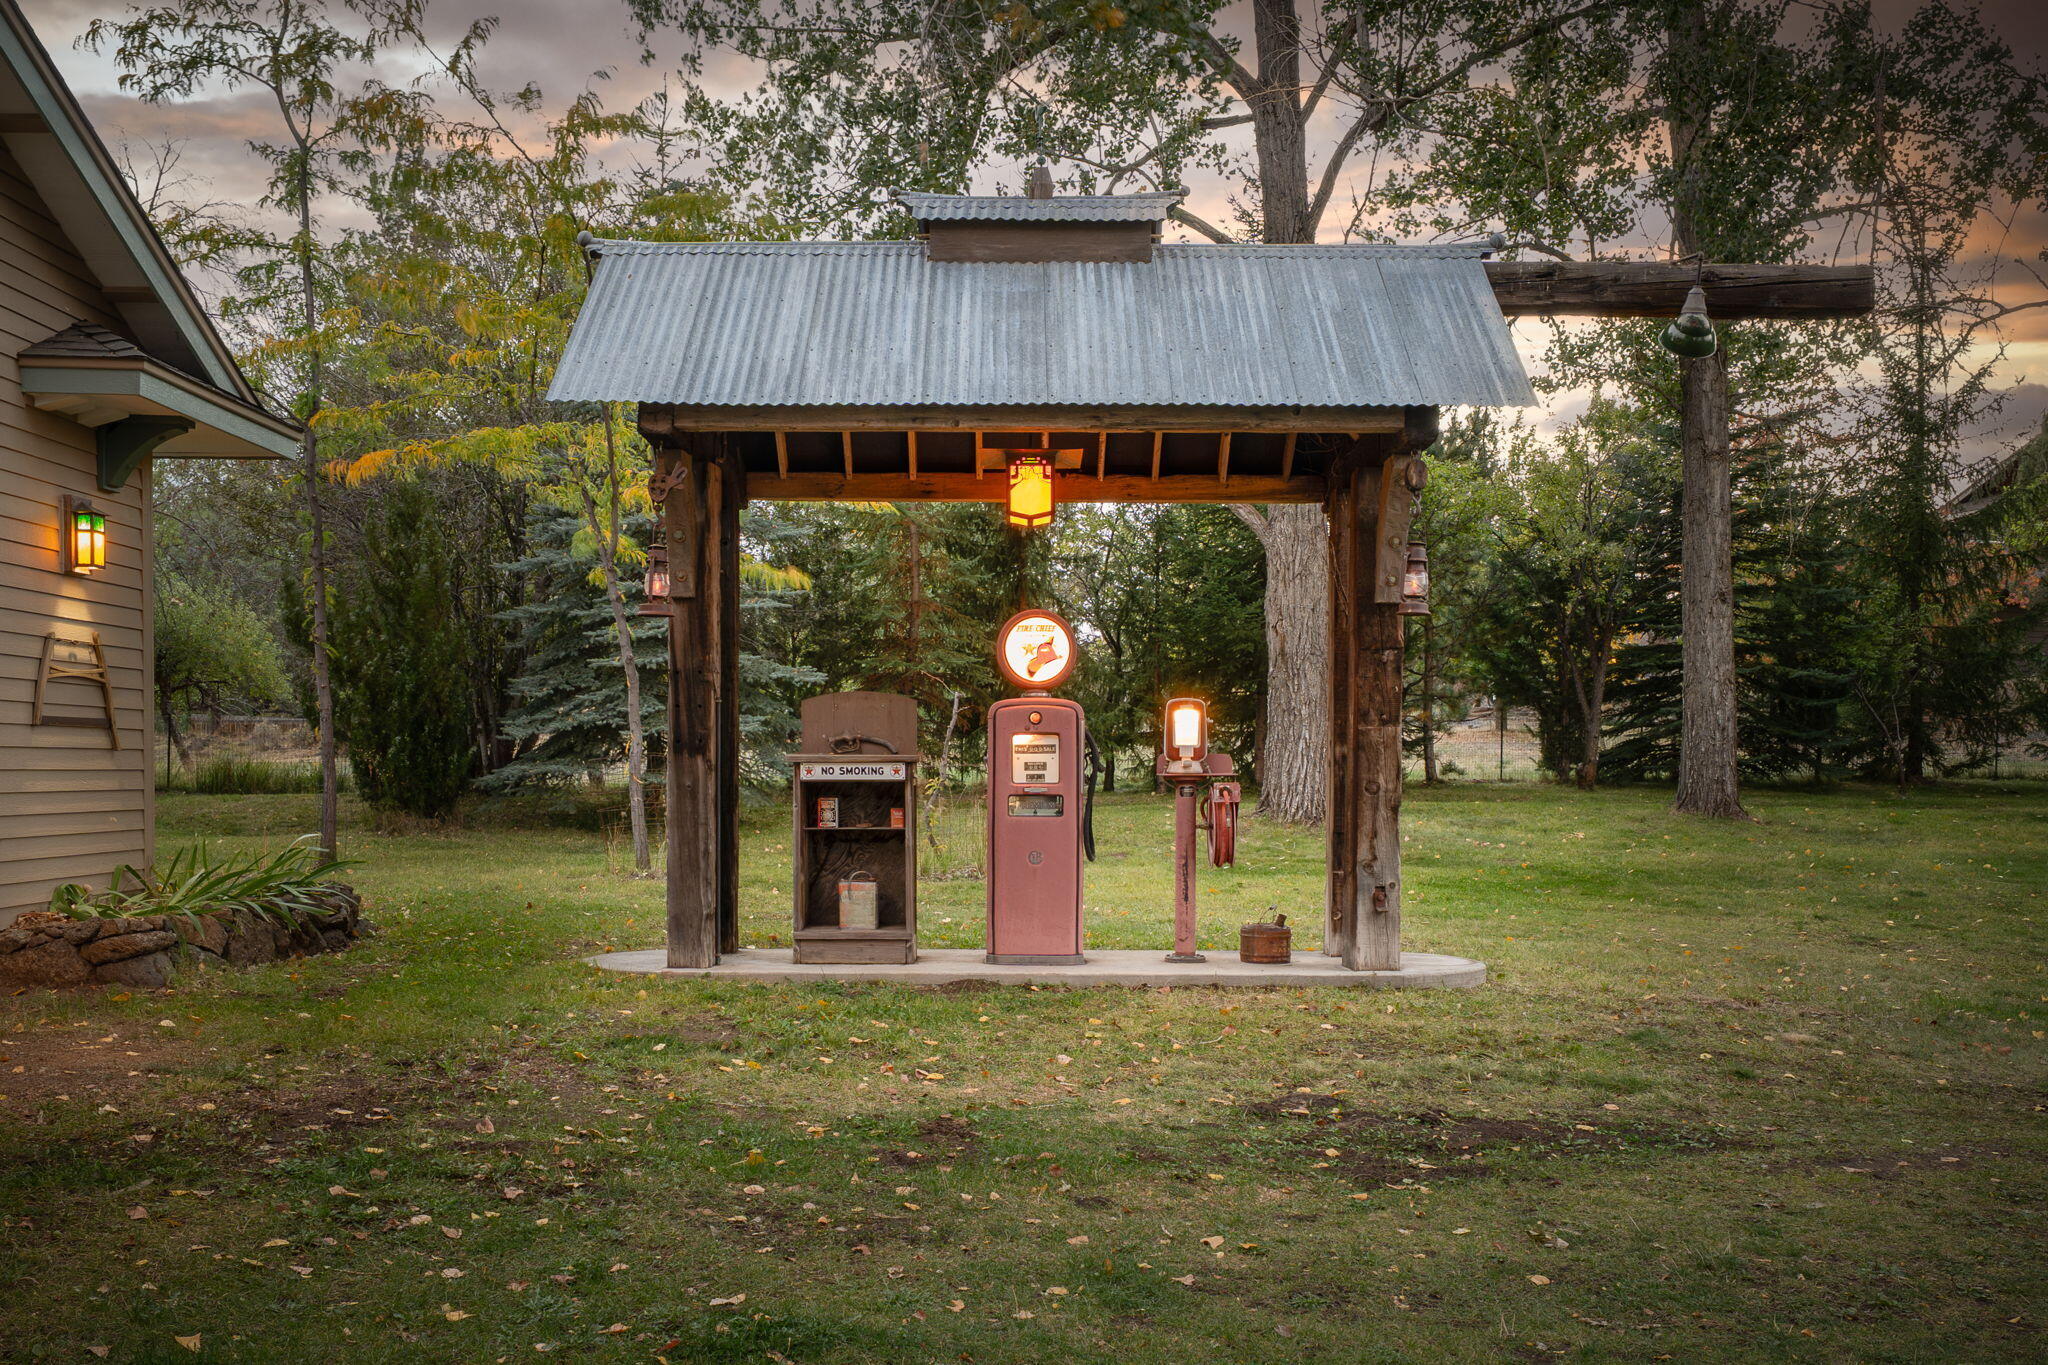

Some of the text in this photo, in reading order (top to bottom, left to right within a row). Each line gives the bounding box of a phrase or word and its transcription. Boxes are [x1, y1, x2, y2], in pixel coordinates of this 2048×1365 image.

[1015, 624, 1057, 632] FIRE CHIEF
[821, 766, 884, 775] NO SMOKING
